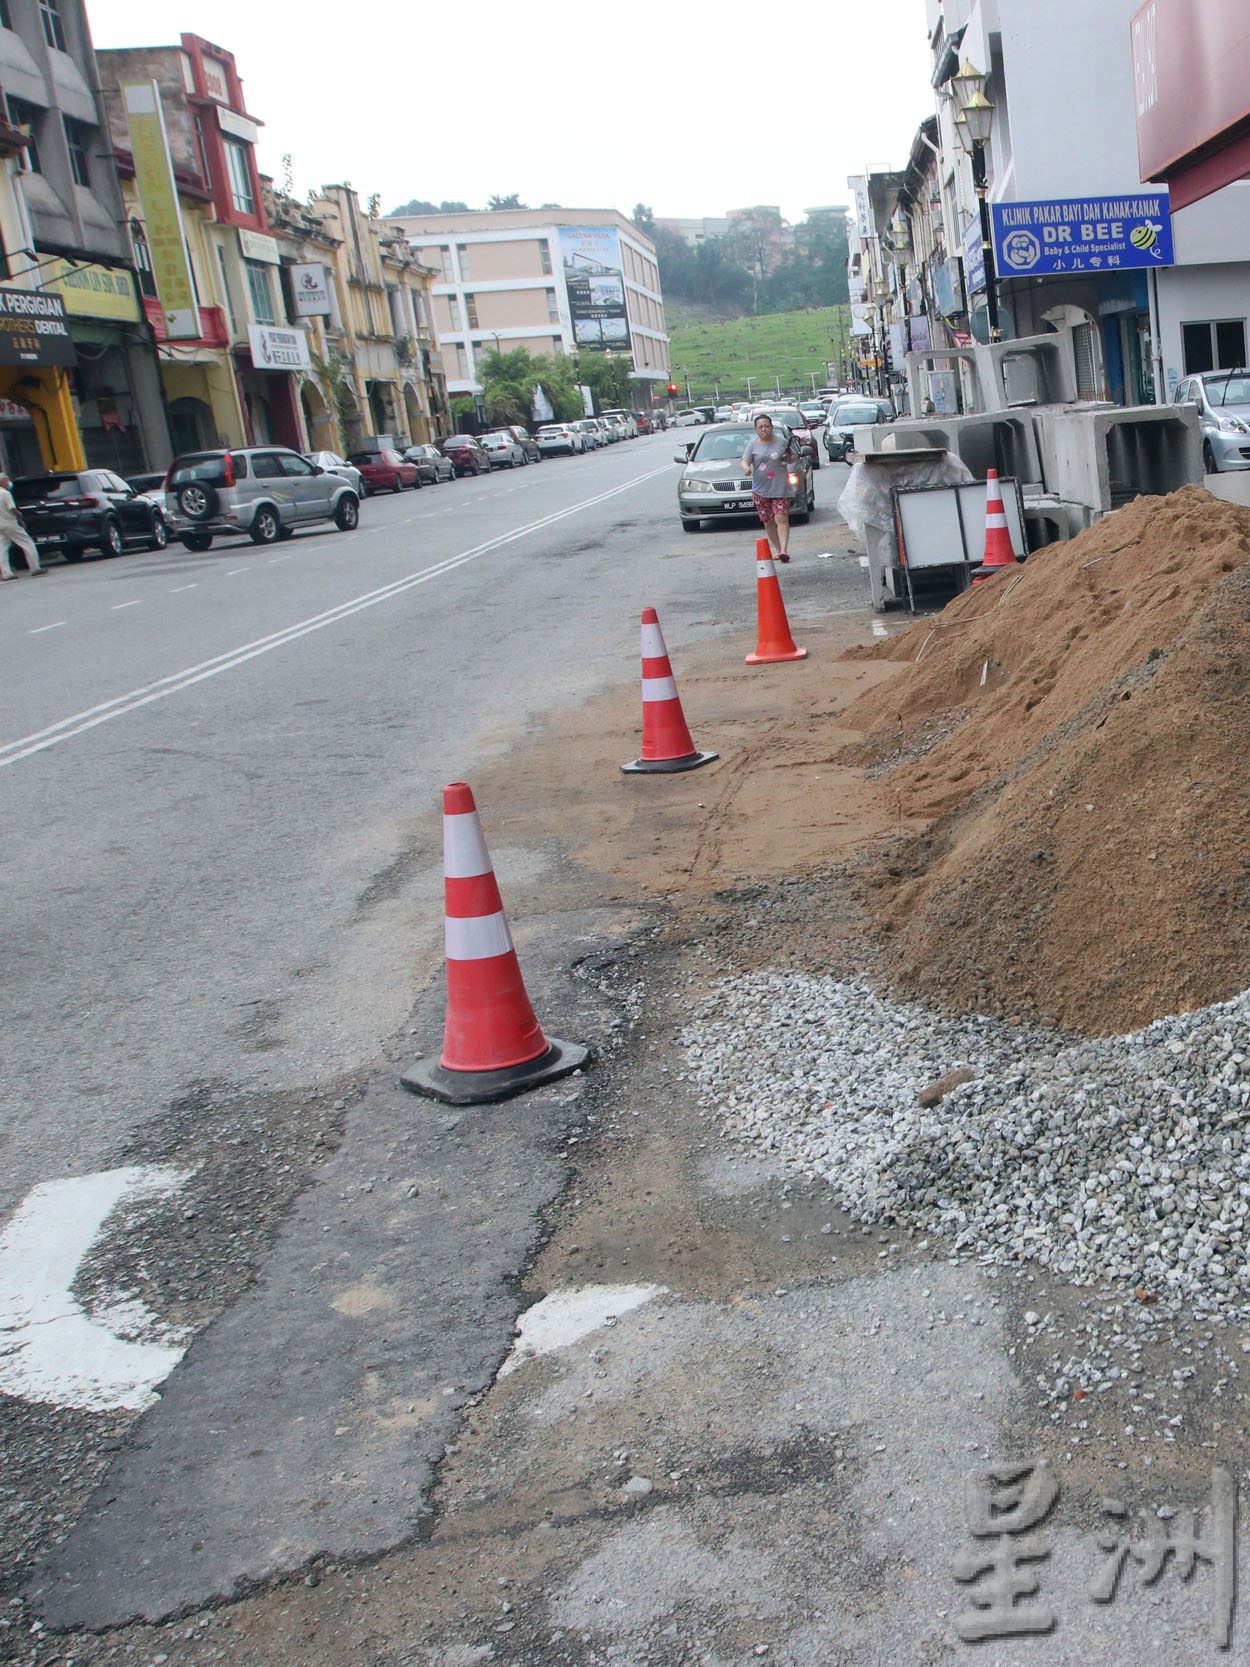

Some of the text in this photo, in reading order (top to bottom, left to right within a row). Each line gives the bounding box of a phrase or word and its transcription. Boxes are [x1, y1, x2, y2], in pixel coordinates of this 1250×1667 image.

[1002, 199, 1161, 226] KLINIK PAKAR BAYI DAN KANAK-KANAK
[1043, 222, 1124, 243] DR BEE
[1044, 241, 1126, 257] Baby & Child Specialist
[1053, 255, 1121, 271] 小儿专科
[5, 293, 64, 317] PERGIGIAN
[34, 320, 69, 336] DENTAL
